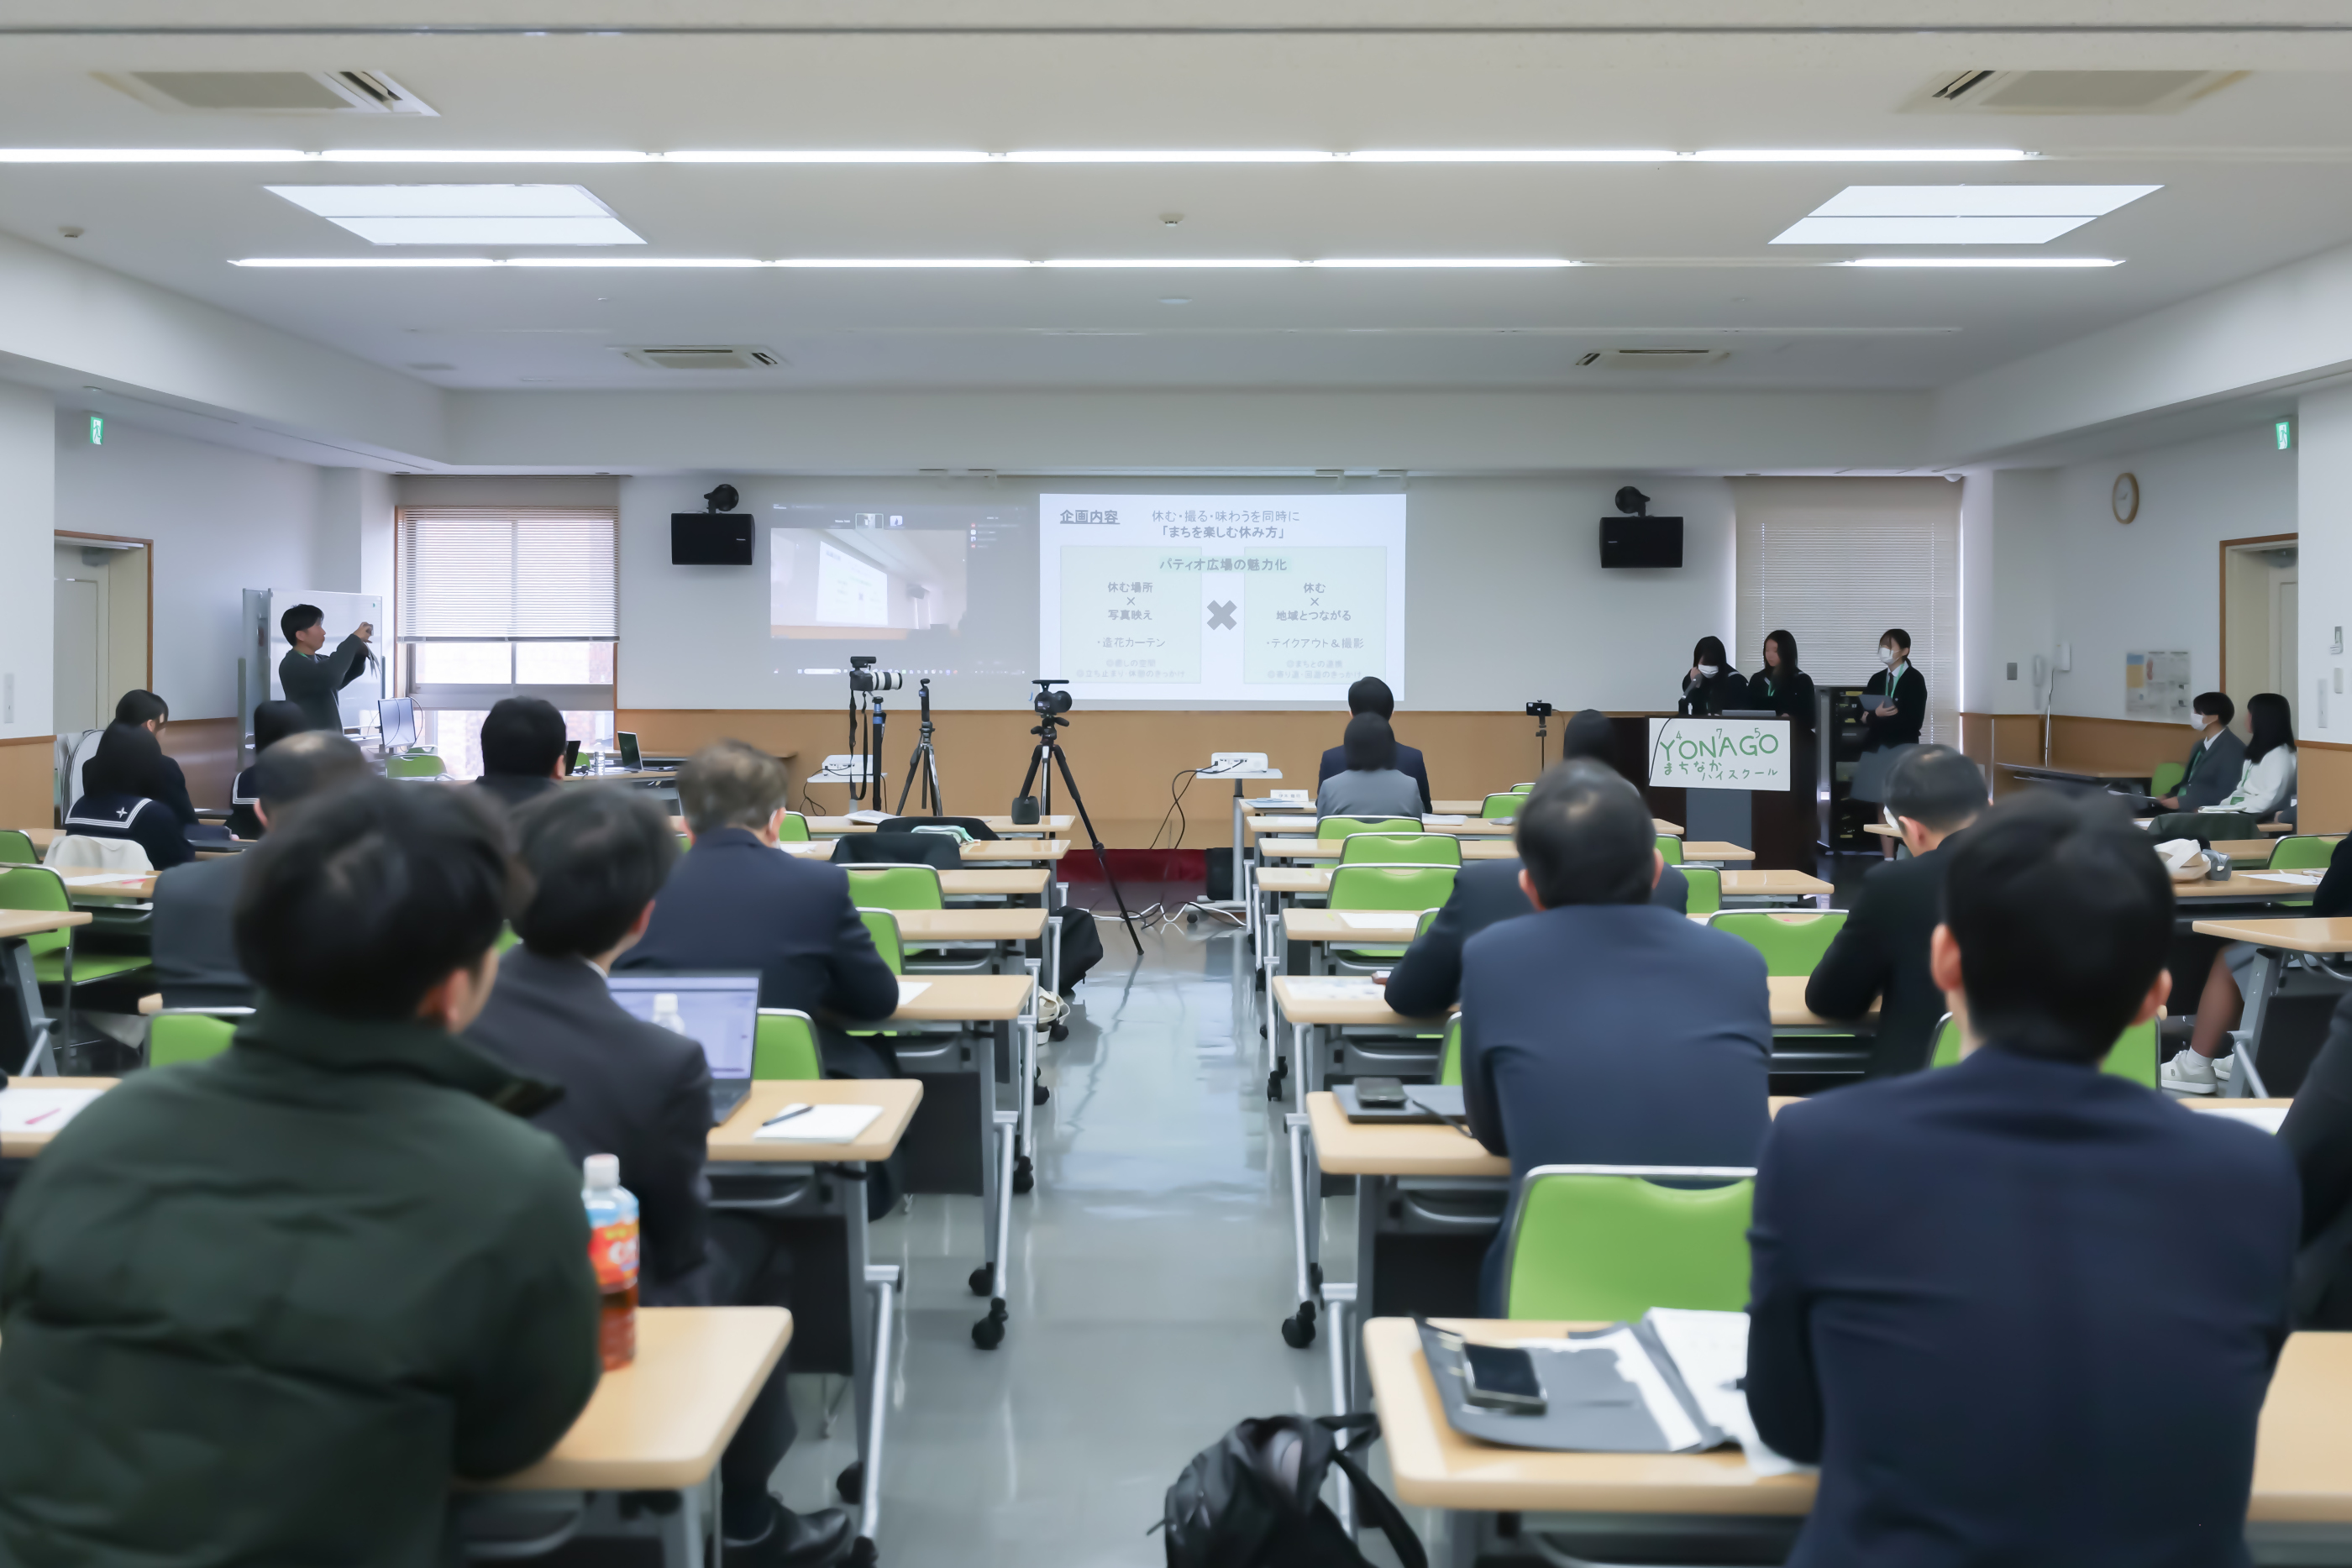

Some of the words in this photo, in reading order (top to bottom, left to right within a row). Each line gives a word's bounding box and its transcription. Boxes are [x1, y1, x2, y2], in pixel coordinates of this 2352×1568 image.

[1059, 509, 1119, 523] 企画内容
[1152, 509, 1300, 523] 休む・撮る・味わうを同時に
[1162, 525, 1284, 540] 「まちを楽しむ休み方」
[1159, 558, 1288, 572] パティオ広場の魅力化
[1107, 581, 1153, 594] 休む場所
[1303, 582, 1327, 594] 休む
[1107, 609, 1153, 621] 写真映え
[1275, 610, 1352, 622] 地域とつながる
[1675, 730, 1683, 741] 4
[1715, 727, 1723, 740] 7
[1754, 727, 1761, 739] 5
[1659, 733, 1779, 762] YONAGO
[1663, 759, 1722, 776] まちなか
[1701, 768, 1778, 782] ハイスクール
